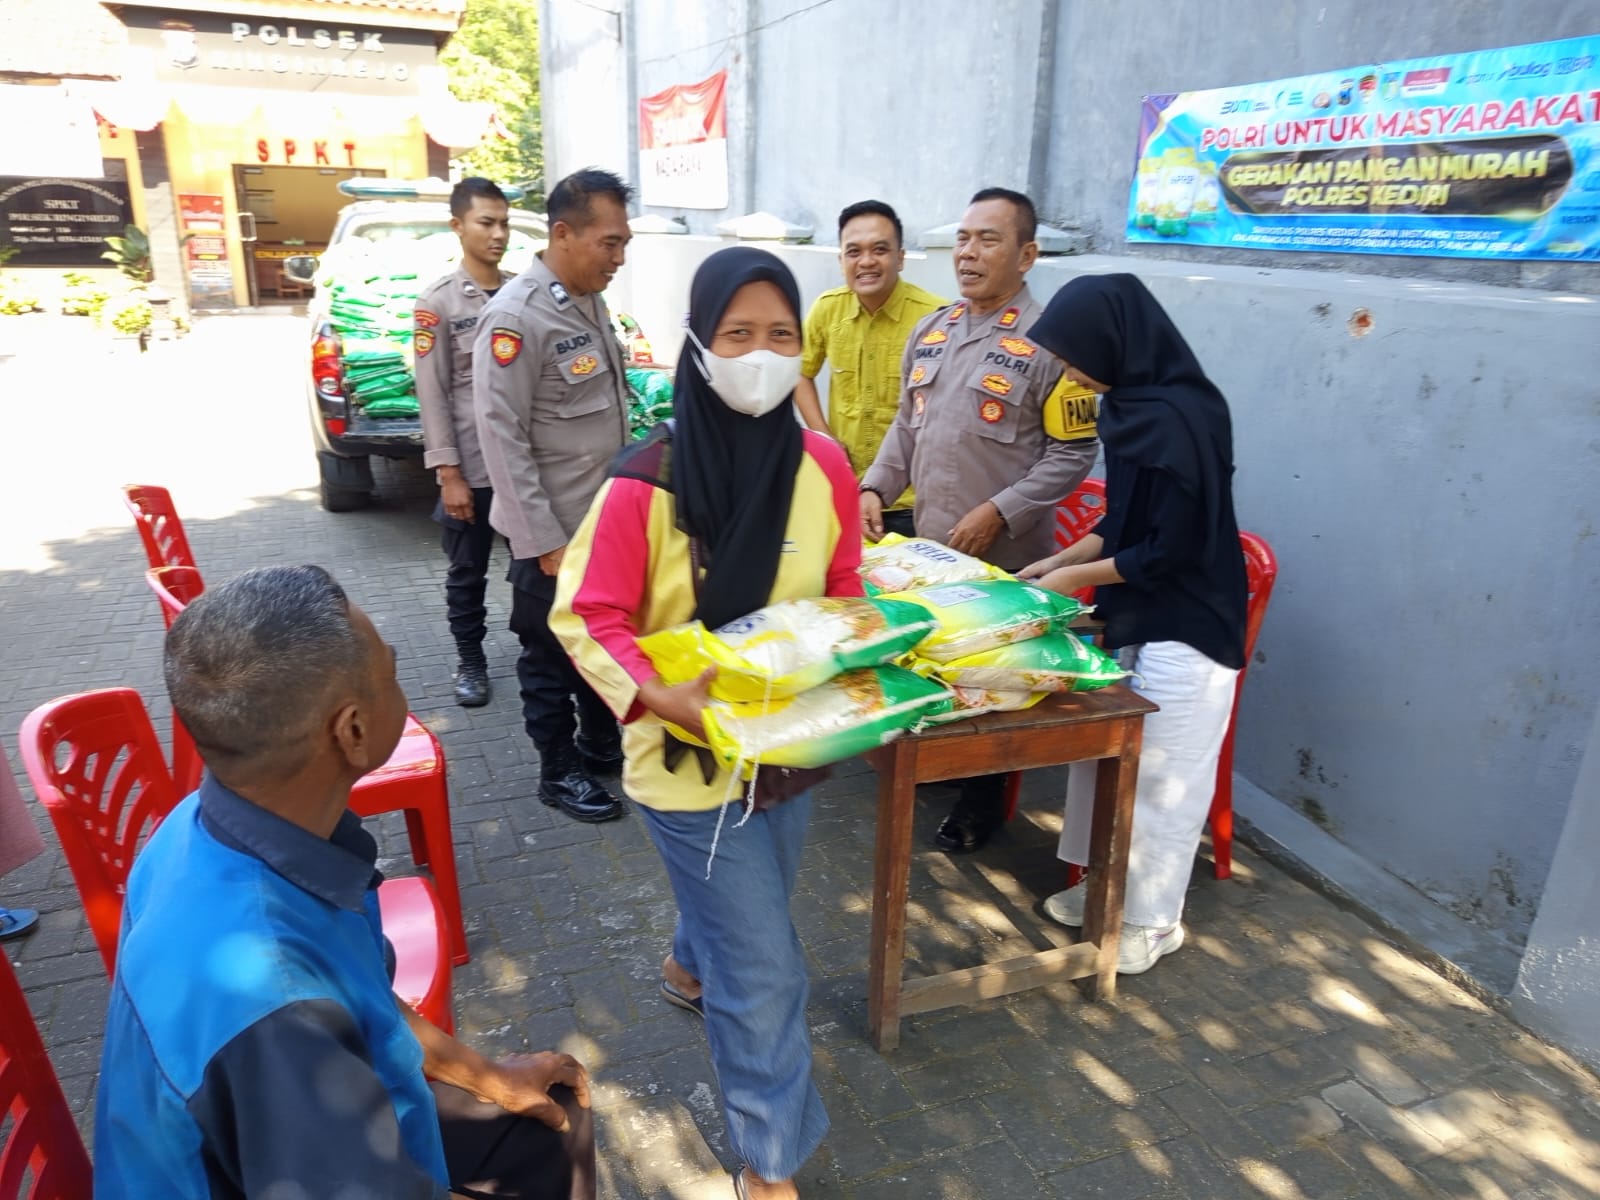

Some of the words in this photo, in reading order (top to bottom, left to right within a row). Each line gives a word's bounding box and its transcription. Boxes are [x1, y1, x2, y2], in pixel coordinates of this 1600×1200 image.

[230, 22, 384, 52] POLSEK
[1201, 123, 1267, 149] POLRI
[1274, 114, 1369, 146] UNTUK
[1374, 90, 1600, 137] MASYARAKAT
[256, 138, 356, 167] SPKT
[1227, 160, 1333, 187] GERAKAN
[1334, 155, 1438, 184] PANGAN
[1440, 149, 1551, 181] MURAH
[1280, 185, 1368, 207] POLRES
[1370, 184, 1450, 207] KEDIRI
[555, 332, 593, 355] BUDI
[983, 351, 1031, 375] POLRI
[908, 541, 958, 563] SPHP
